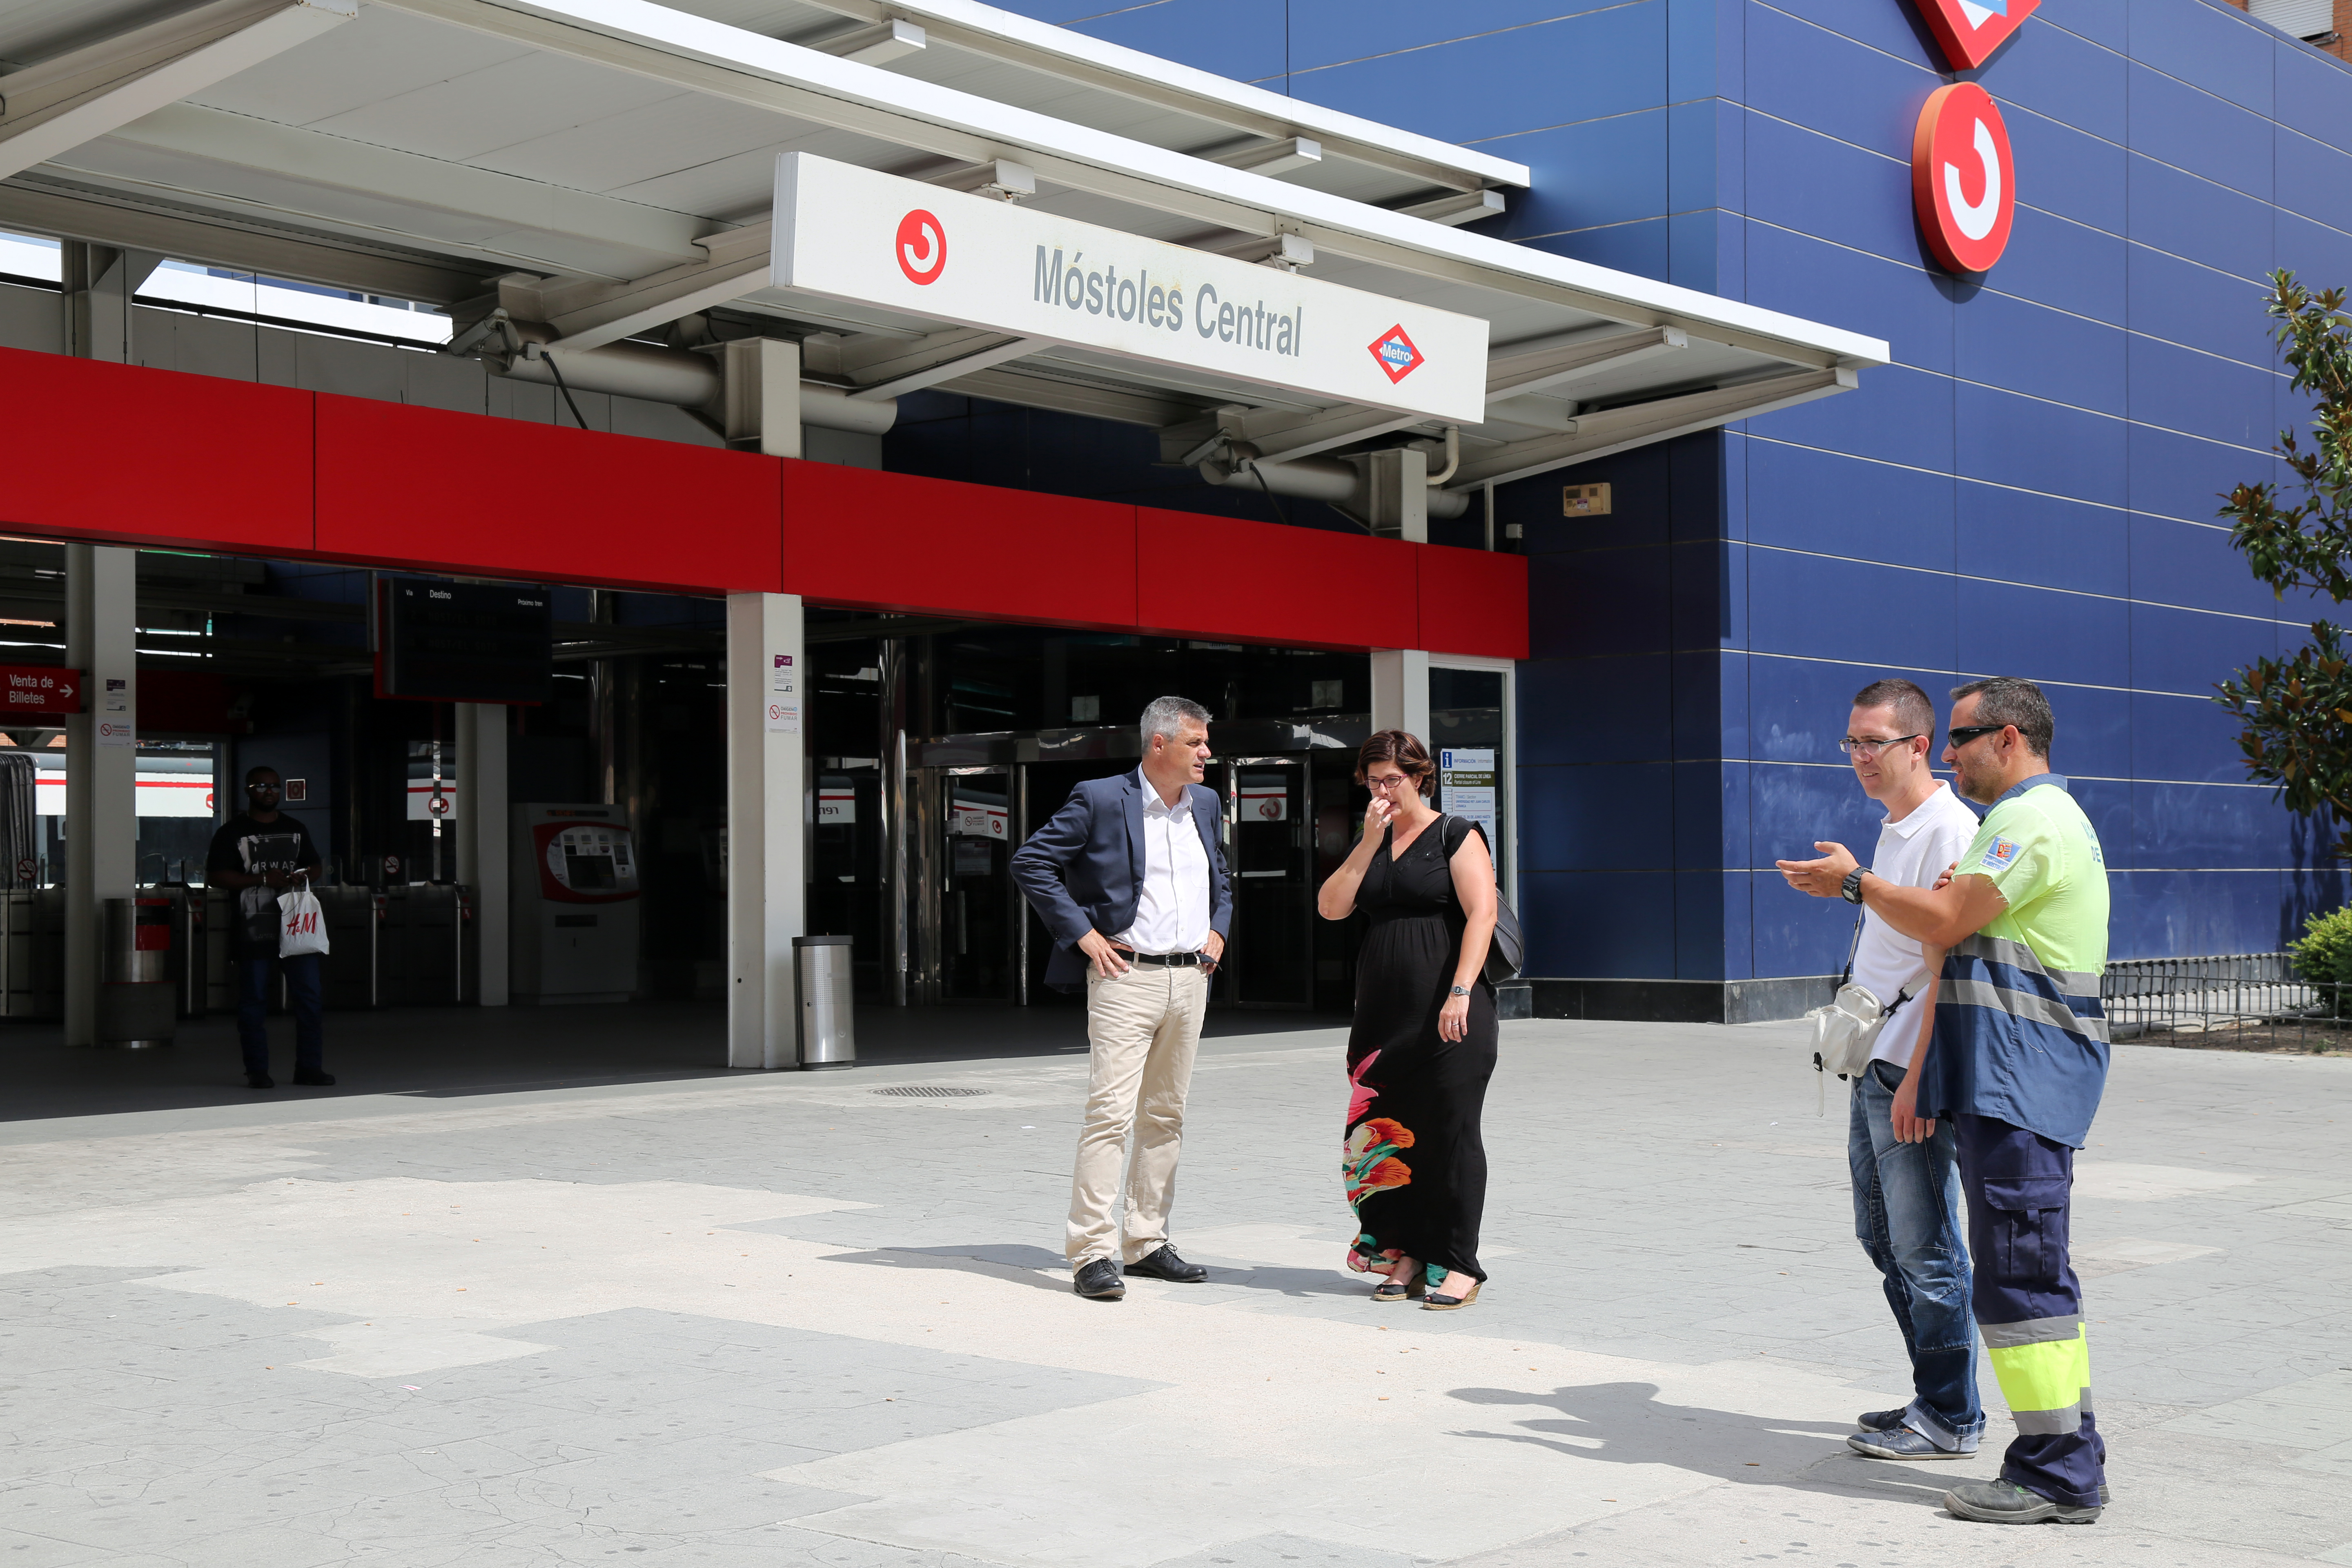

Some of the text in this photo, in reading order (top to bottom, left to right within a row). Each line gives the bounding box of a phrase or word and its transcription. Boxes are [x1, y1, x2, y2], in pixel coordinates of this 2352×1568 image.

[1034, 245, 1302, 357] Móstoles Central
[1383, 343, 1410, 362] Metro
[430, 590, 451, 599] Destino
[9, 674, 53, 688] Venta de
[9, 691, 45, 704] Billetes
[1443, 772, 1452, 785] 12
[286, 912, 317, 936] H&M
